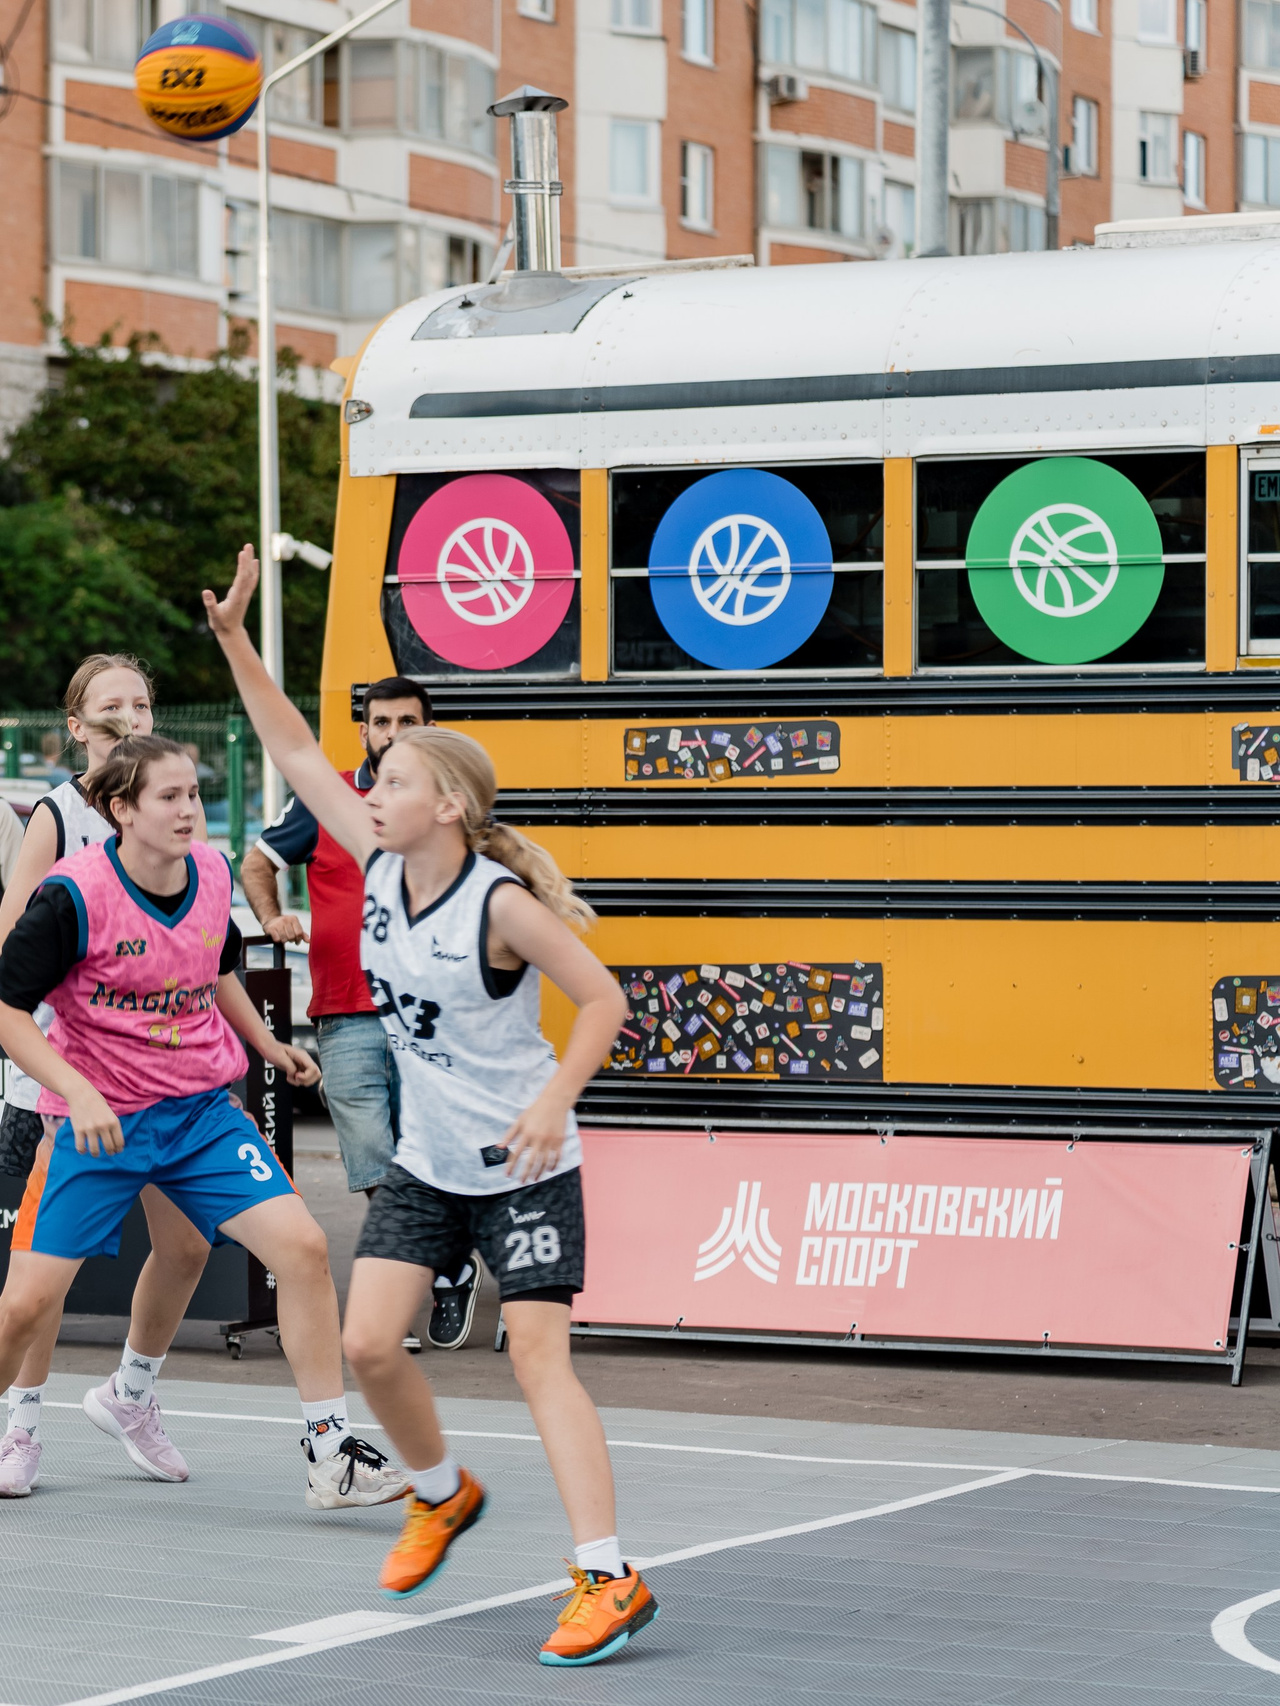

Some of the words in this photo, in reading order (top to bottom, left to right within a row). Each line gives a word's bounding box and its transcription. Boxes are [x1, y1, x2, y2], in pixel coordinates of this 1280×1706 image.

[238, 1143, 273, 1182] 3
[803, 1177, 1064, 1240] МОСКОВСКИЙ
[505, 1225, 561, 1272] 28
[795, 1236, 919, 1289] СПОРТ
